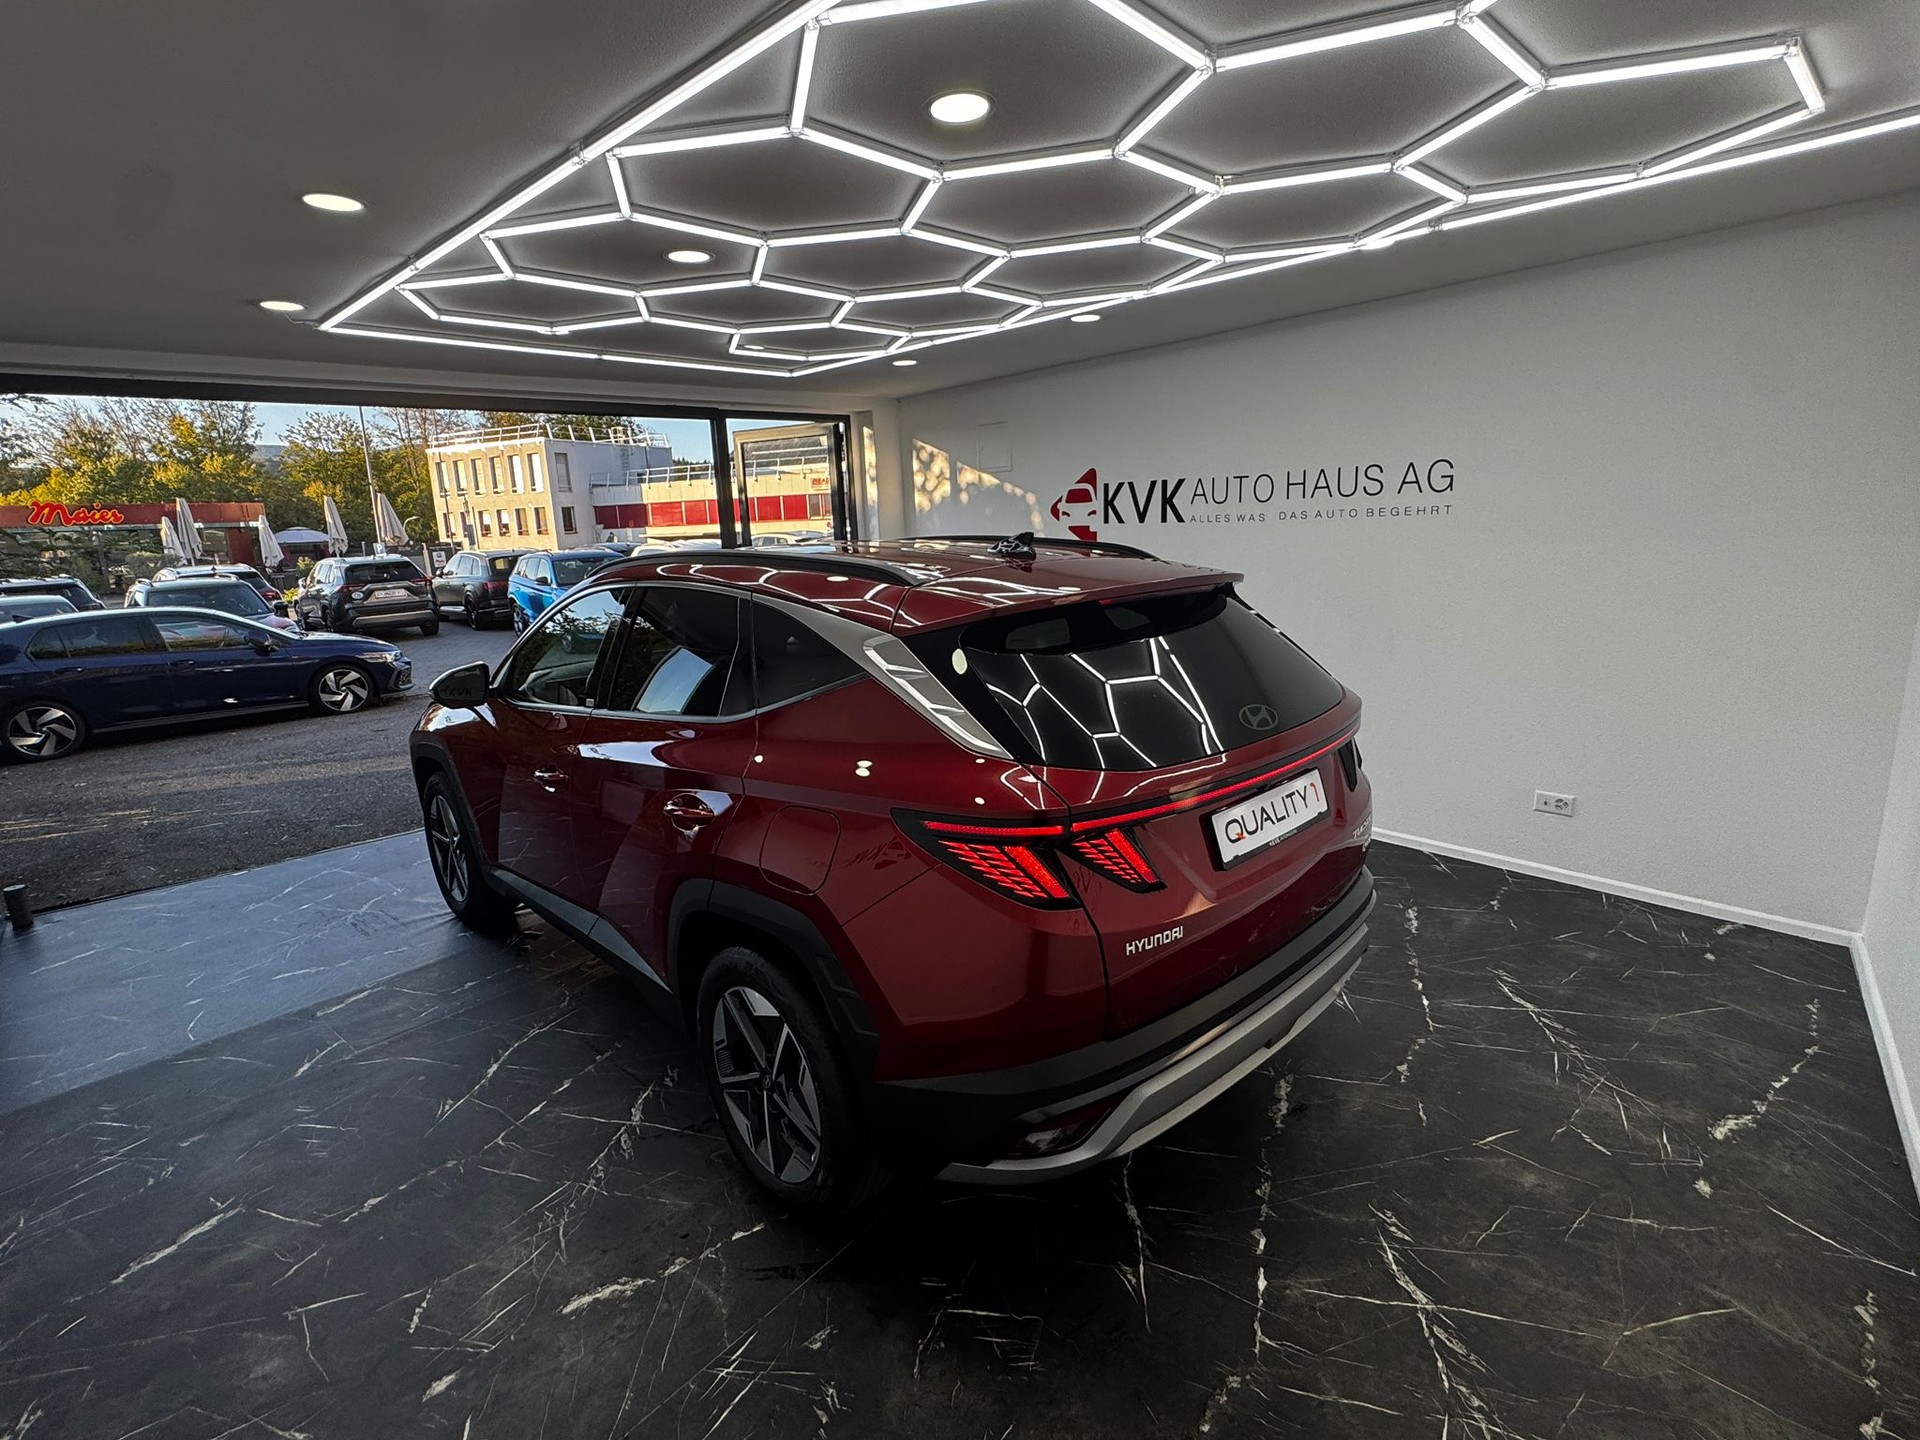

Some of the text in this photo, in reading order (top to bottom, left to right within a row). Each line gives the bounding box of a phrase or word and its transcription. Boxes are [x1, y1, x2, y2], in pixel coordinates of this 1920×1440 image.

[1102, 458, 1454, 524] KVK AUTO HAUS AG
[1190, 504, 1453, 523] ALLES WAS DAS AUTO BEGEHRT
[1125, 925, 1184, 956] HYUNDAI
